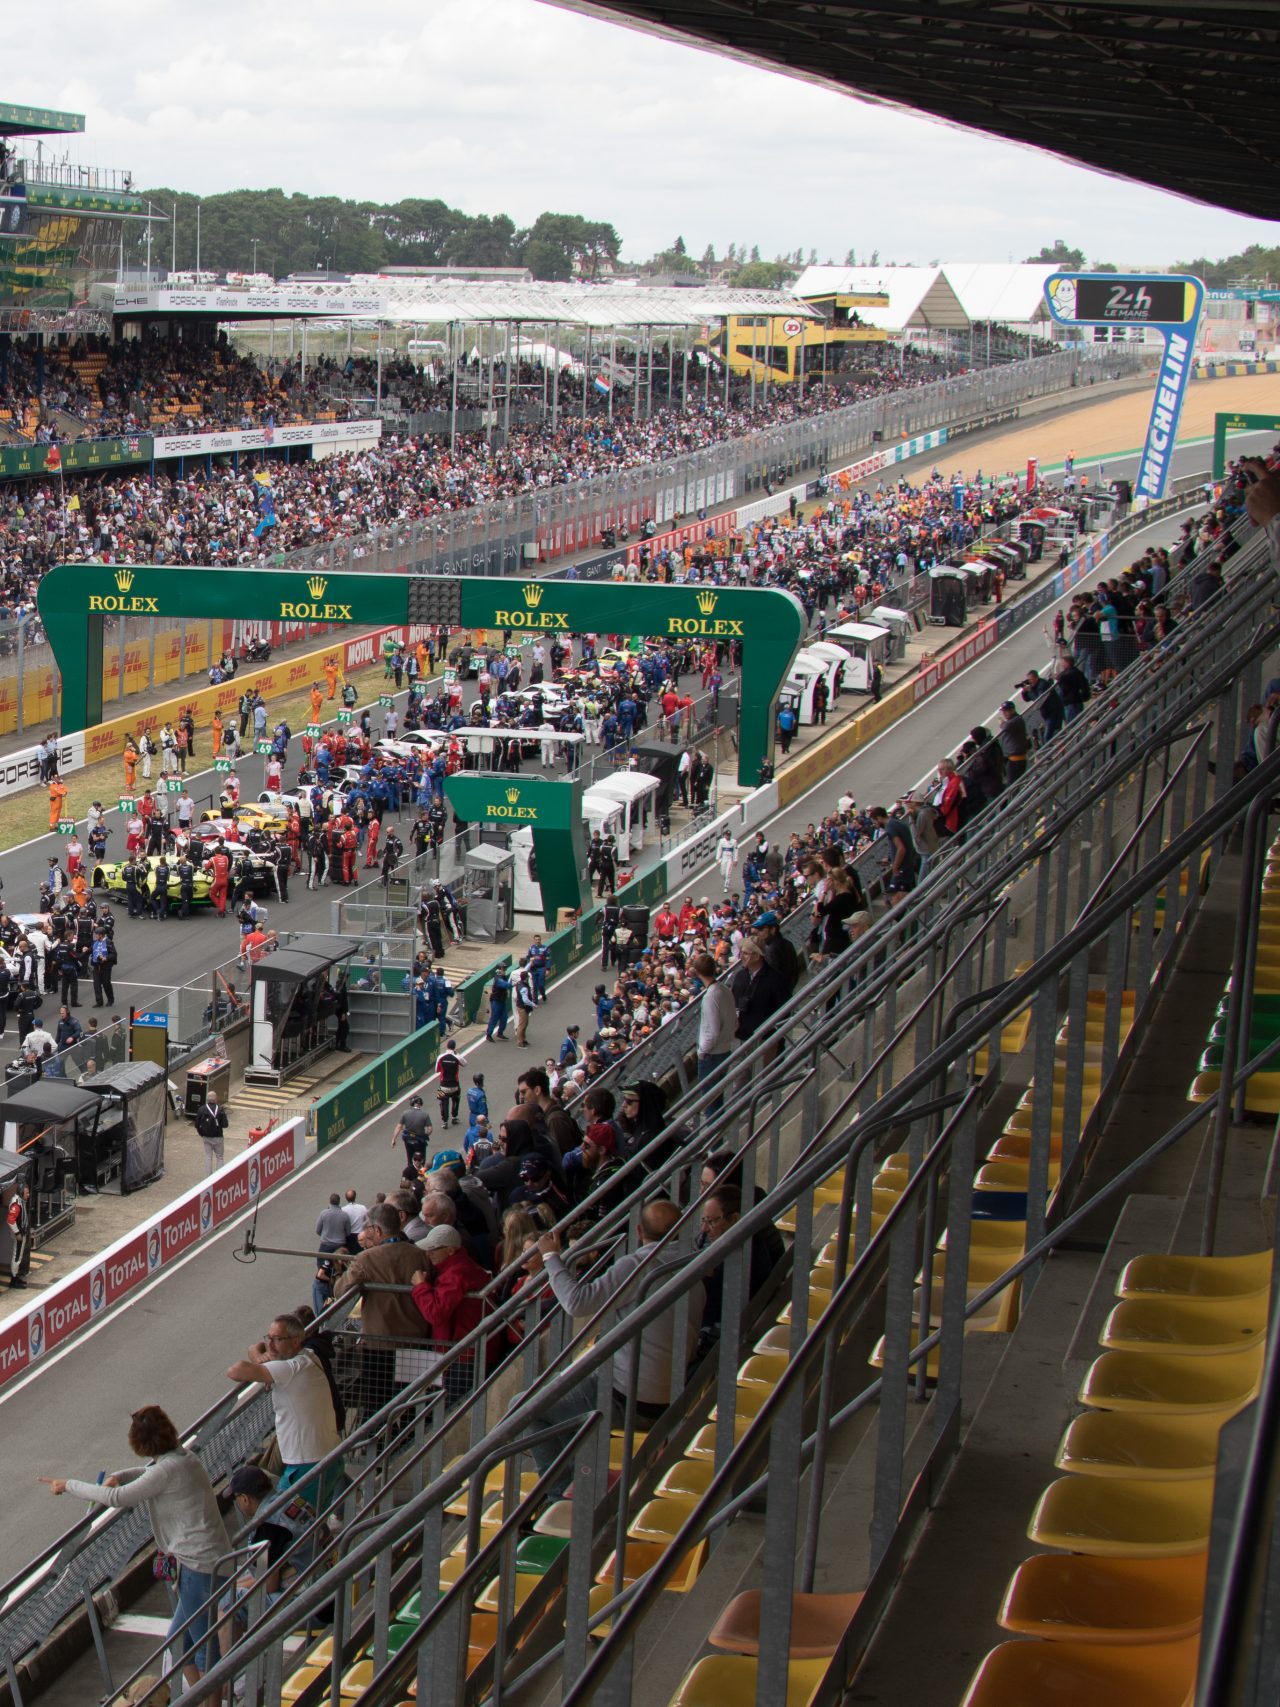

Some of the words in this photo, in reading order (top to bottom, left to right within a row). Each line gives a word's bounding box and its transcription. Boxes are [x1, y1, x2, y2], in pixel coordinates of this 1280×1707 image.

[1104, 309, 1115, 317] LE
[1118, 309, 1149, 317] MANS
[1141, 332, 1188, 495] MICHELIN
[241, 433, 265, 445] PORSC
[586, 563, 602, 577] GANT
[88, 595, 159, 612] ROLEX
[280, 602, 352, 620] ROLEX
[494, 610, 569, 629] ROLEX
[668, 617, 744, 636] ROLEX
[347, 637, 373, 667] MOTUL
[380, 697, 392, 707] 92
[340, 712, 351, 722] 71
[307, 727, 319, 737] 66
[91, 730, 116, 752] DHL
[260, 743, 272, 753] 69
[216, 761, 230, 771] 64
[169, 781, 181, 791] 51
[121, 800, 134, 812] 91
[486, 804, 538, 819] ROLEX
[59, 823, 75, 835] 97
[153, 1015, 166, 1023] 36
[263, 1148, 294, 1175] TOTAL
[216, 1183, 248, 1212] TOTAL
[163, 1220, 199, 1252] TOTAL
[108, 1257, 146, 1291] TOTAL
[48, 1297, 88, 1333] TOTAL
